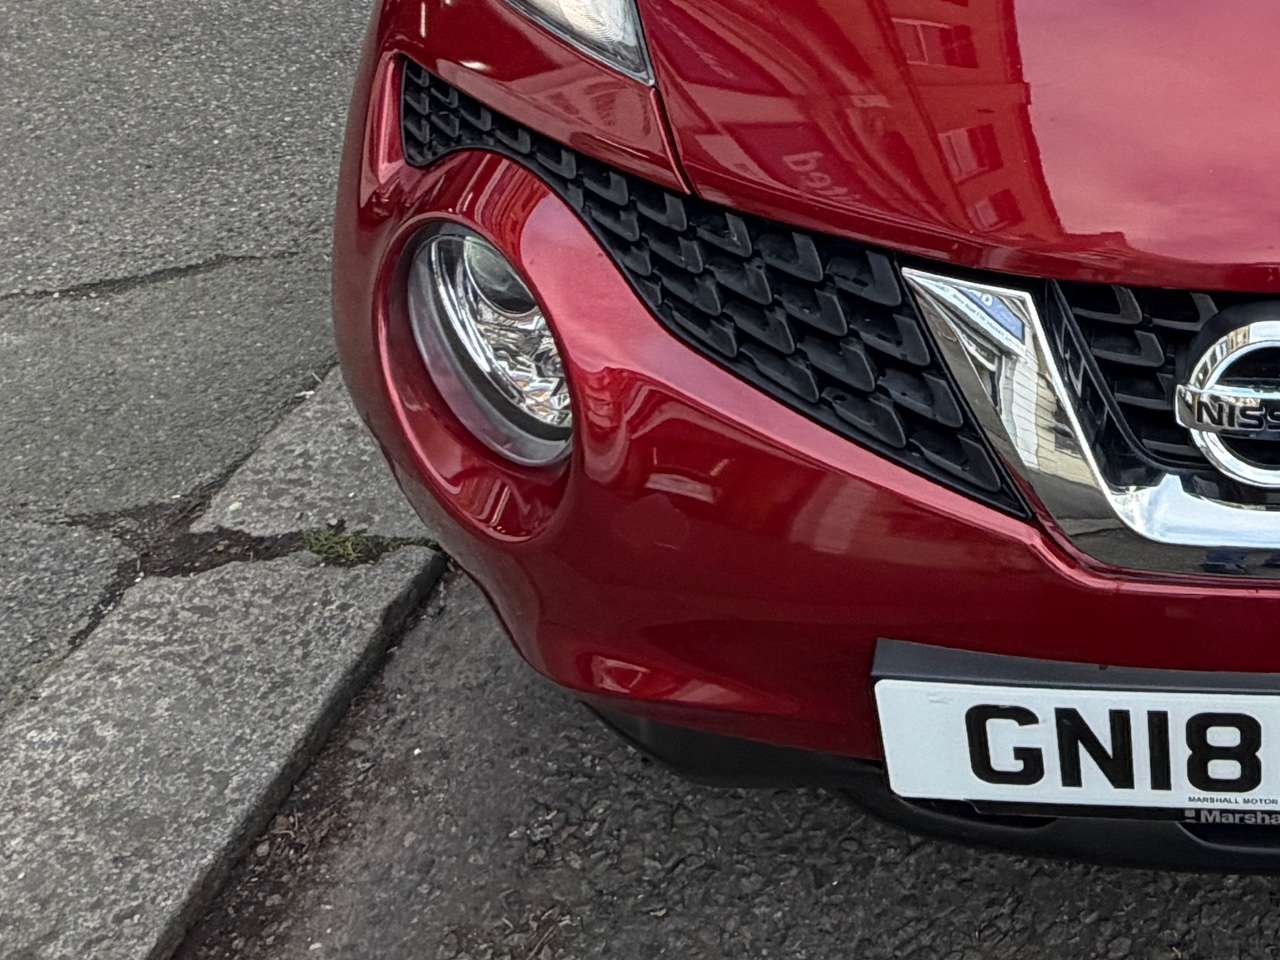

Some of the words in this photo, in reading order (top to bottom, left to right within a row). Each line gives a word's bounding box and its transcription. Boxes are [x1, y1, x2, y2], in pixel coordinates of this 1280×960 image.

[965, 704, 1262, 793] GN18
[1188, 796, 1239, 805] MARSHALL
[1243, 798, 1278, 806] MOTOR
